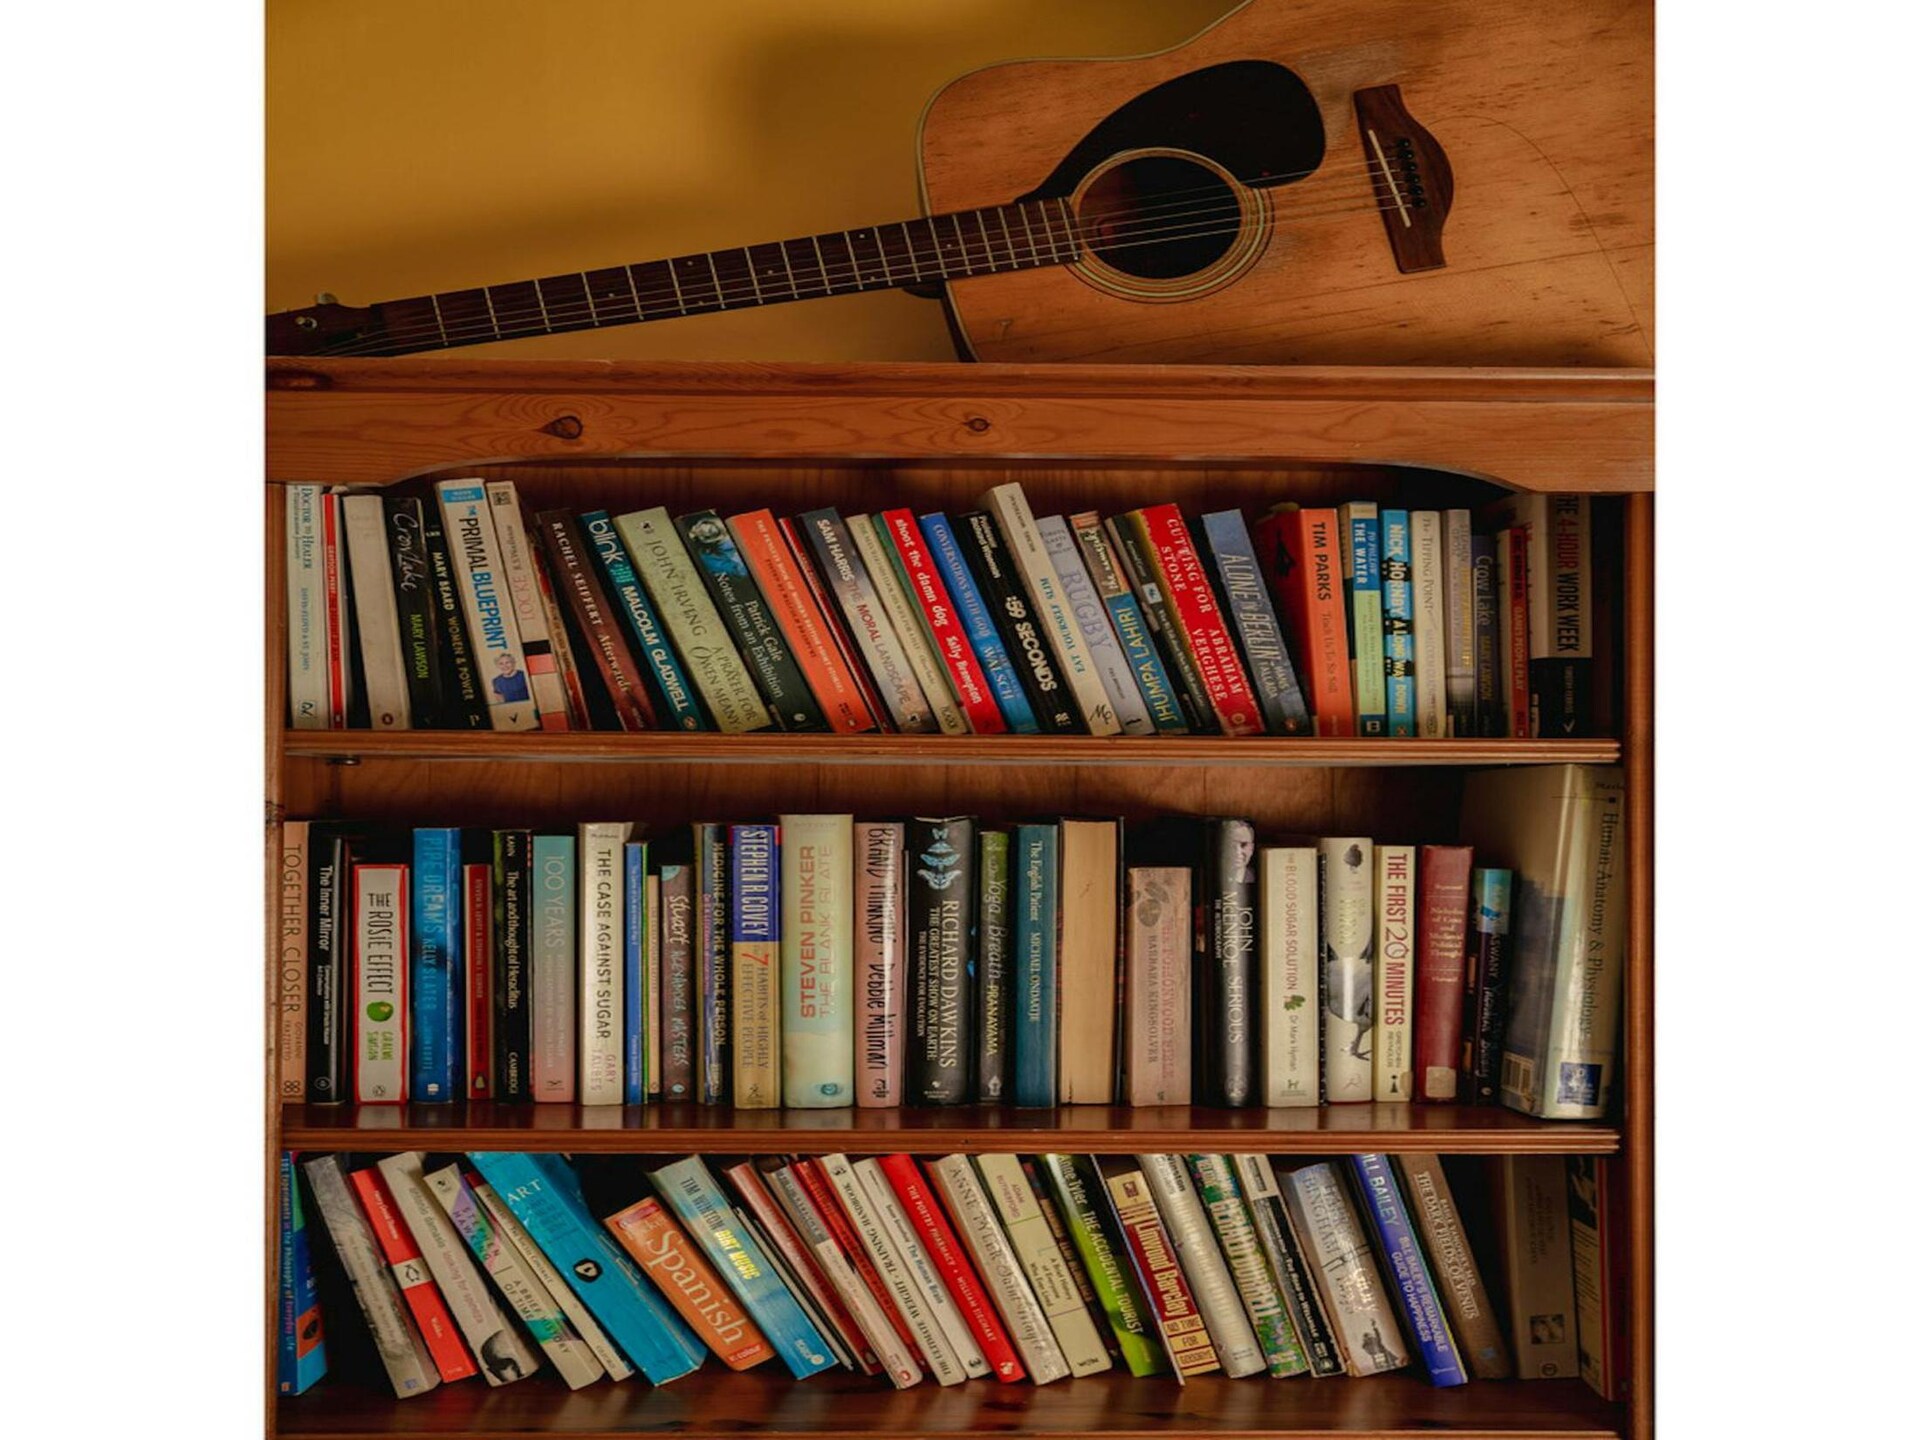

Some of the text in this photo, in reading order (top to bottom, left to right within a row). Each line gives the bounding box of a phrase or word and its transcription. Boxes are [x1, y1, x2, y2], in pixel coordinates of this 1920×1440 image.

[551, 522, 574, 569] RACHEL
[572, 572, 602, 626] SEIFFERT
[588, 519, 625, 565] blink
[816, 519, 853, 581] SAM HARRIS
[895, 519, 948, 627] shoot the damn dog
[934, 524, 979, 615] CONVERSATIONS WITH
[1160, 545, 1186, 592] STONE
[1166, 518, 1212, 613] CUTTING FOR
[1312, 522, 1331, 601] TIM PARKS
[1354, 523, 1367, 584] THE WATER
[432, 552, 456, 610] MARY BEARD
[646, 539, 706, 637] JOHN IRVING
[1061, 572, 1112, 649] RUGBY
[1220, 554, 1280, 660] ALONE BERLIN
[1474, 555, 1494, 626] Crow Lake
[1557, 518, 1580, 651] 4-HOUR WORK WEEK
[410, 614, 428, 678] MARY LAWSON
[448, 616, 473, 700] WOMEN POWER
[597, 633, 631, 692] Afterwards
[621, 585, 688, 711] MALCOLM GLADWELL
[714, 574, 784, 698] Notes from an Exhibition
[744, 600, 784, 661] Patrick Gale
[856, 604, 911, 705] MORAL LANDSCAPE
[1015, 622, 1057, 692] SECONDS
[1051, 604, 1076, 651] YOURSELF
[1116, 608, 1148, 659] LAHIRI
[1209, 629, 1242, 694] ABRAHAM
[944, 636, 982, 704] Sally Brampton
[983, 647, 1015, 700] WALSCH
[1140, 662, 1172, 722] JHUMPA
[1191, 628, 1228, 701] VERGHESE
[505, 835, 516, 857] KAHN
[545, 855, 564, 890] 100
[1027, 841, 1043, 921] The English Patient
[1387, 854, 1408, 880] THE
[318, 865, 333, 951] The Inner Mirror
[422, 837, 444, 933] PIPE DREAMS
[740, 830, 769, 936] STEPHEN COVEY
[865, 827, 898, 945] BRAND THINKING
[1385, 885, 1407, 925] FIRST
[545, 895, 564, 948] YEARS
[596, 850, 611, 1038] THE CASE AGAINST SUGAR
[668, 894, 690, 945] Stuart
[712, 842, 726, 1045] MEDICINE FOR THE WHOLE PERSON
[800, 847, 816, 1018] STEVEN PINKER
[819, 846, 836, 1019] THE BLANK SLATE
[987, 879, 1008, 979] Yoga Breath
[1240, 906, 1254, 951] JOHN
[1285, 865, 1298, 990] BLOOD SUGAR SOLUTION
[1579, 812, 1619, 1038] Human Anatomy Physiology
[282, 947, 302, 1012] CLOSER
[368, 954, 393, 994] EFFECT
[422, 938, 437, 1010] KELLY SLATER
[507, 965, 520, 1009] Heraclitus
[741, 953, 769, 965] 7
[927, 907, 940, 1007] THE GREATEST SHOW
[939, 900, 960, 1068] RICHARD DAWKINS
[1027, 932, 1041, 1022] MICHAEL ONDAATJE
[741, 963, 754, 1069] EFFECTIVE PEOPLE
[865, 963, 897, 1070] Debbie Millman
[985, 983, 999, 1056] PRANAYAMA
[1147, 935, 1159, 1063] BARBARA KINGSOLVER
[1228, 975, 1244, 1044] SERIOUS
[1384, 962, 1406, 1025] MINUTES
[382, 1031, 393, 1061] GRAEME
[605, 1054, 616, 1083] GARY
[507, 1179, 541, 1205] ART
[680, 1177, 702, 1196] TIM
[949, 1167, 978, 1213] ANNE
[1063, 1179, 1087, 1205] Tyler
[1368, 1176, 1399, 1226] BAILEY
[714, 1230, 760, 1280] DIRT MUSIC
[906, 1185, 955, 1267] THE POETRY PHARMACY
[1416, 1171, 1479, 1320] THE DARK FIELDS OF VENUS
[282, 1247, 294, 1288] Philosophy
[645, 1230, 746, 1345] Spanish
[957, 1276, 978, 1308] WILLIAM
[1081, 1210, 1143, 1334] THE ACCIDENTAL TOURIST
[1135, 1223, 1191, 1317] Linwood Barclay
[1391, 1251, 1432, 1342] GUIDE TO HAPPINESS
[1399, 1237, 1412, 1254] BILL
[1416, 1294, 1448, 1352] REMARKABLE
[1182, 1335, 1200, 1347] FOR
